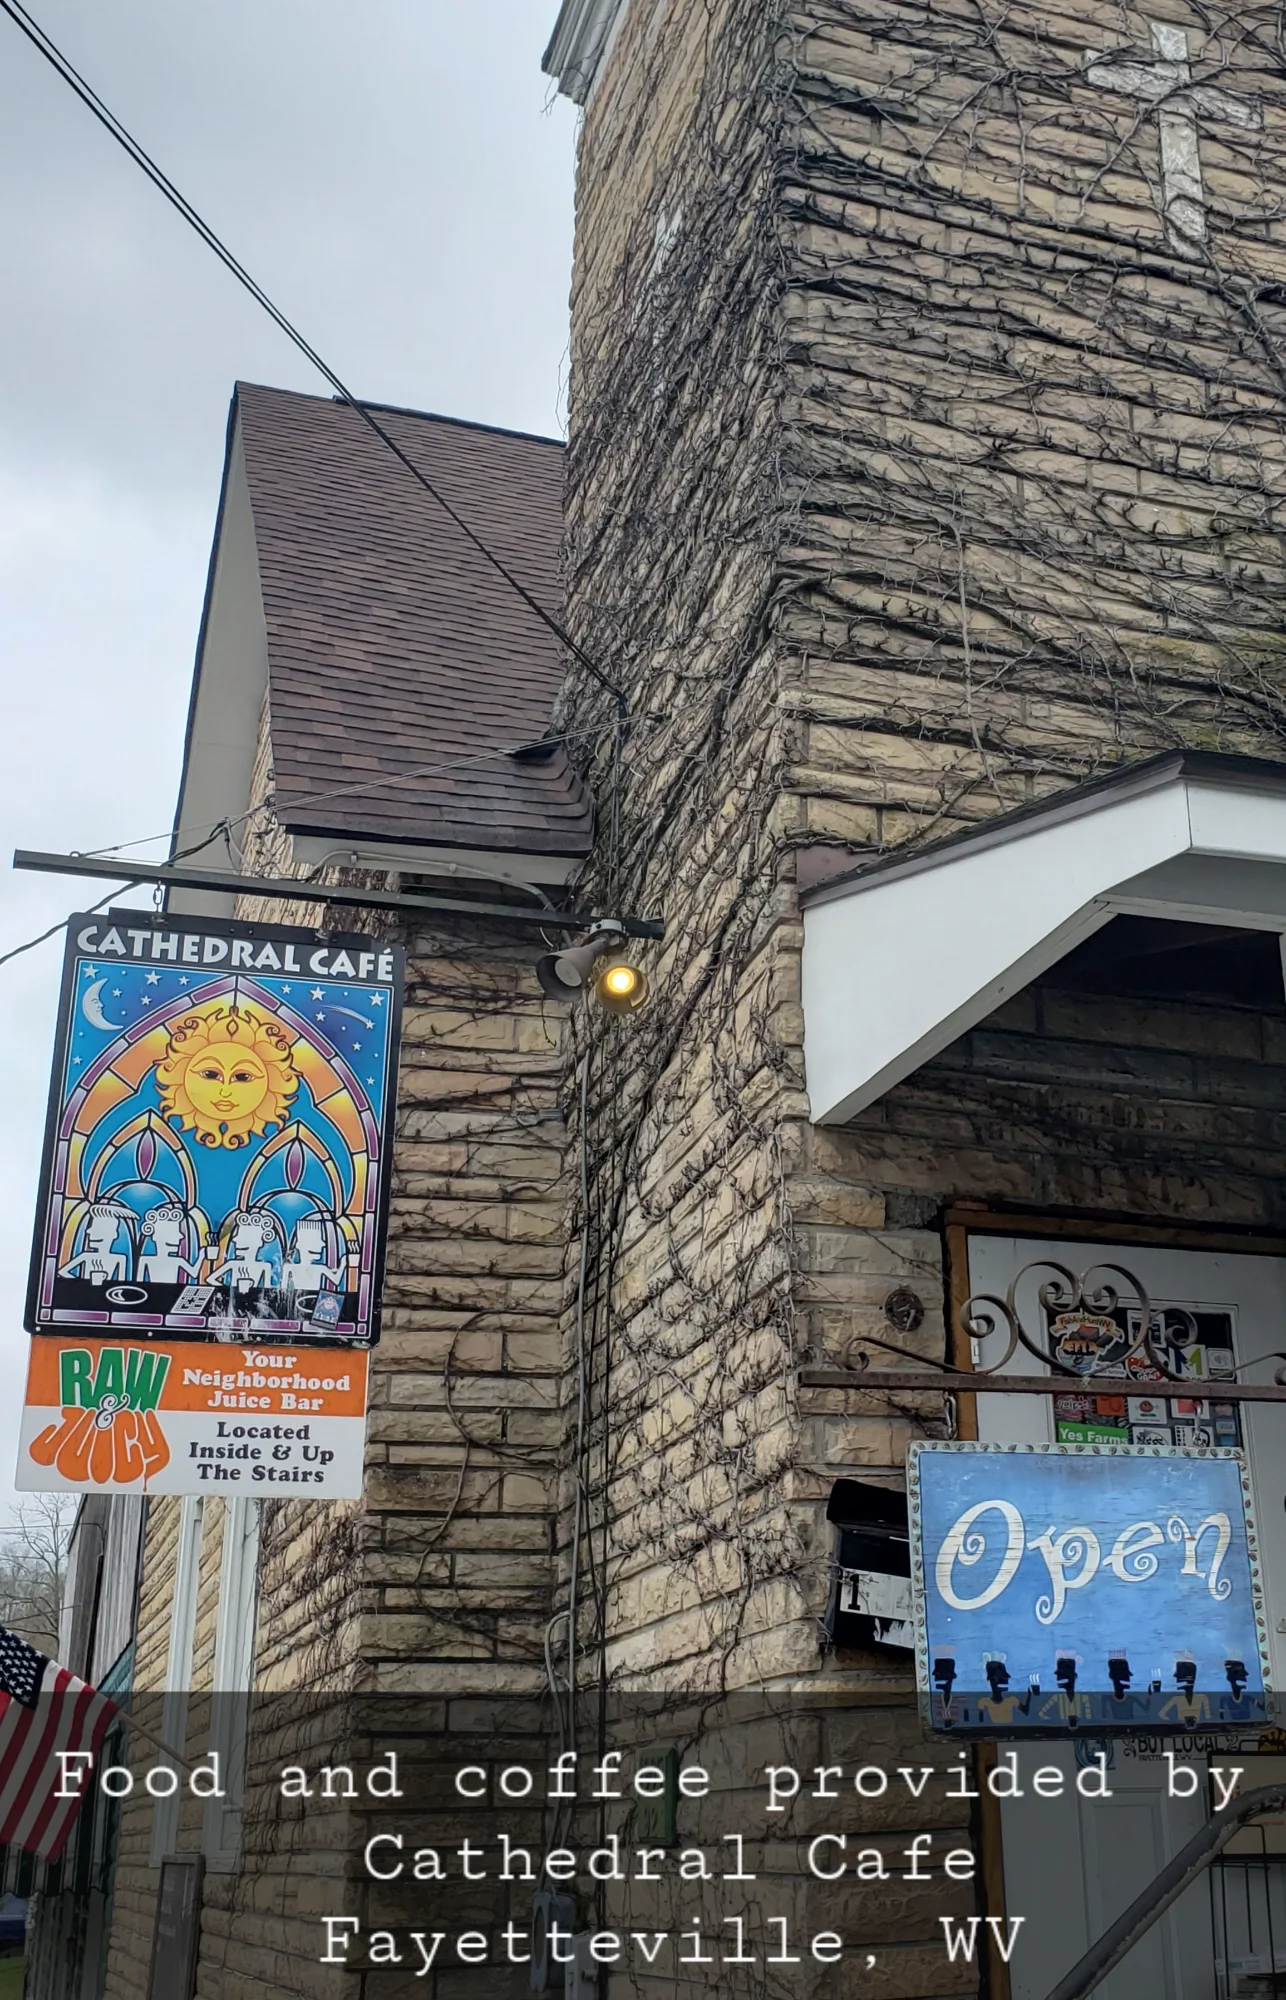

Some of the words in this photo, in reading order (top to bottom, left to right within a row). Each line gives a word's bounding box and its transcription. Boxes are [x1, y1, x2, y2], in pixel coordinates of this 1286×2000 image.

[76, 925, 301, 972] CATHEDRAL
[309, 948, 395, 982] CAFÉ
[242, 1350, 297, 1369] Your
[59, 1347, 172, 1411] RAW
[182, 1369, 350, 1391] Neighborhood
[94, 1393, 131, 1430] &
[208, 1390, 271, 1410] Juice
[280, 1394, 323, 1412] Bar
[216, 1421, 310, 1441] Located
[1059, 1427, 1085, 1443] Yes
[1086, 1431, 1129, 1446] Farms
[188, 1442, 262, 1461] Inside
[272, 1445, 292, 1460] &
[302, 1445, 335, 1465] Up
[197, 1463, 241, 1481] The
[251, 1466, 325, 1484] Stairs
[935, 1499, 1233, 1625] Open
